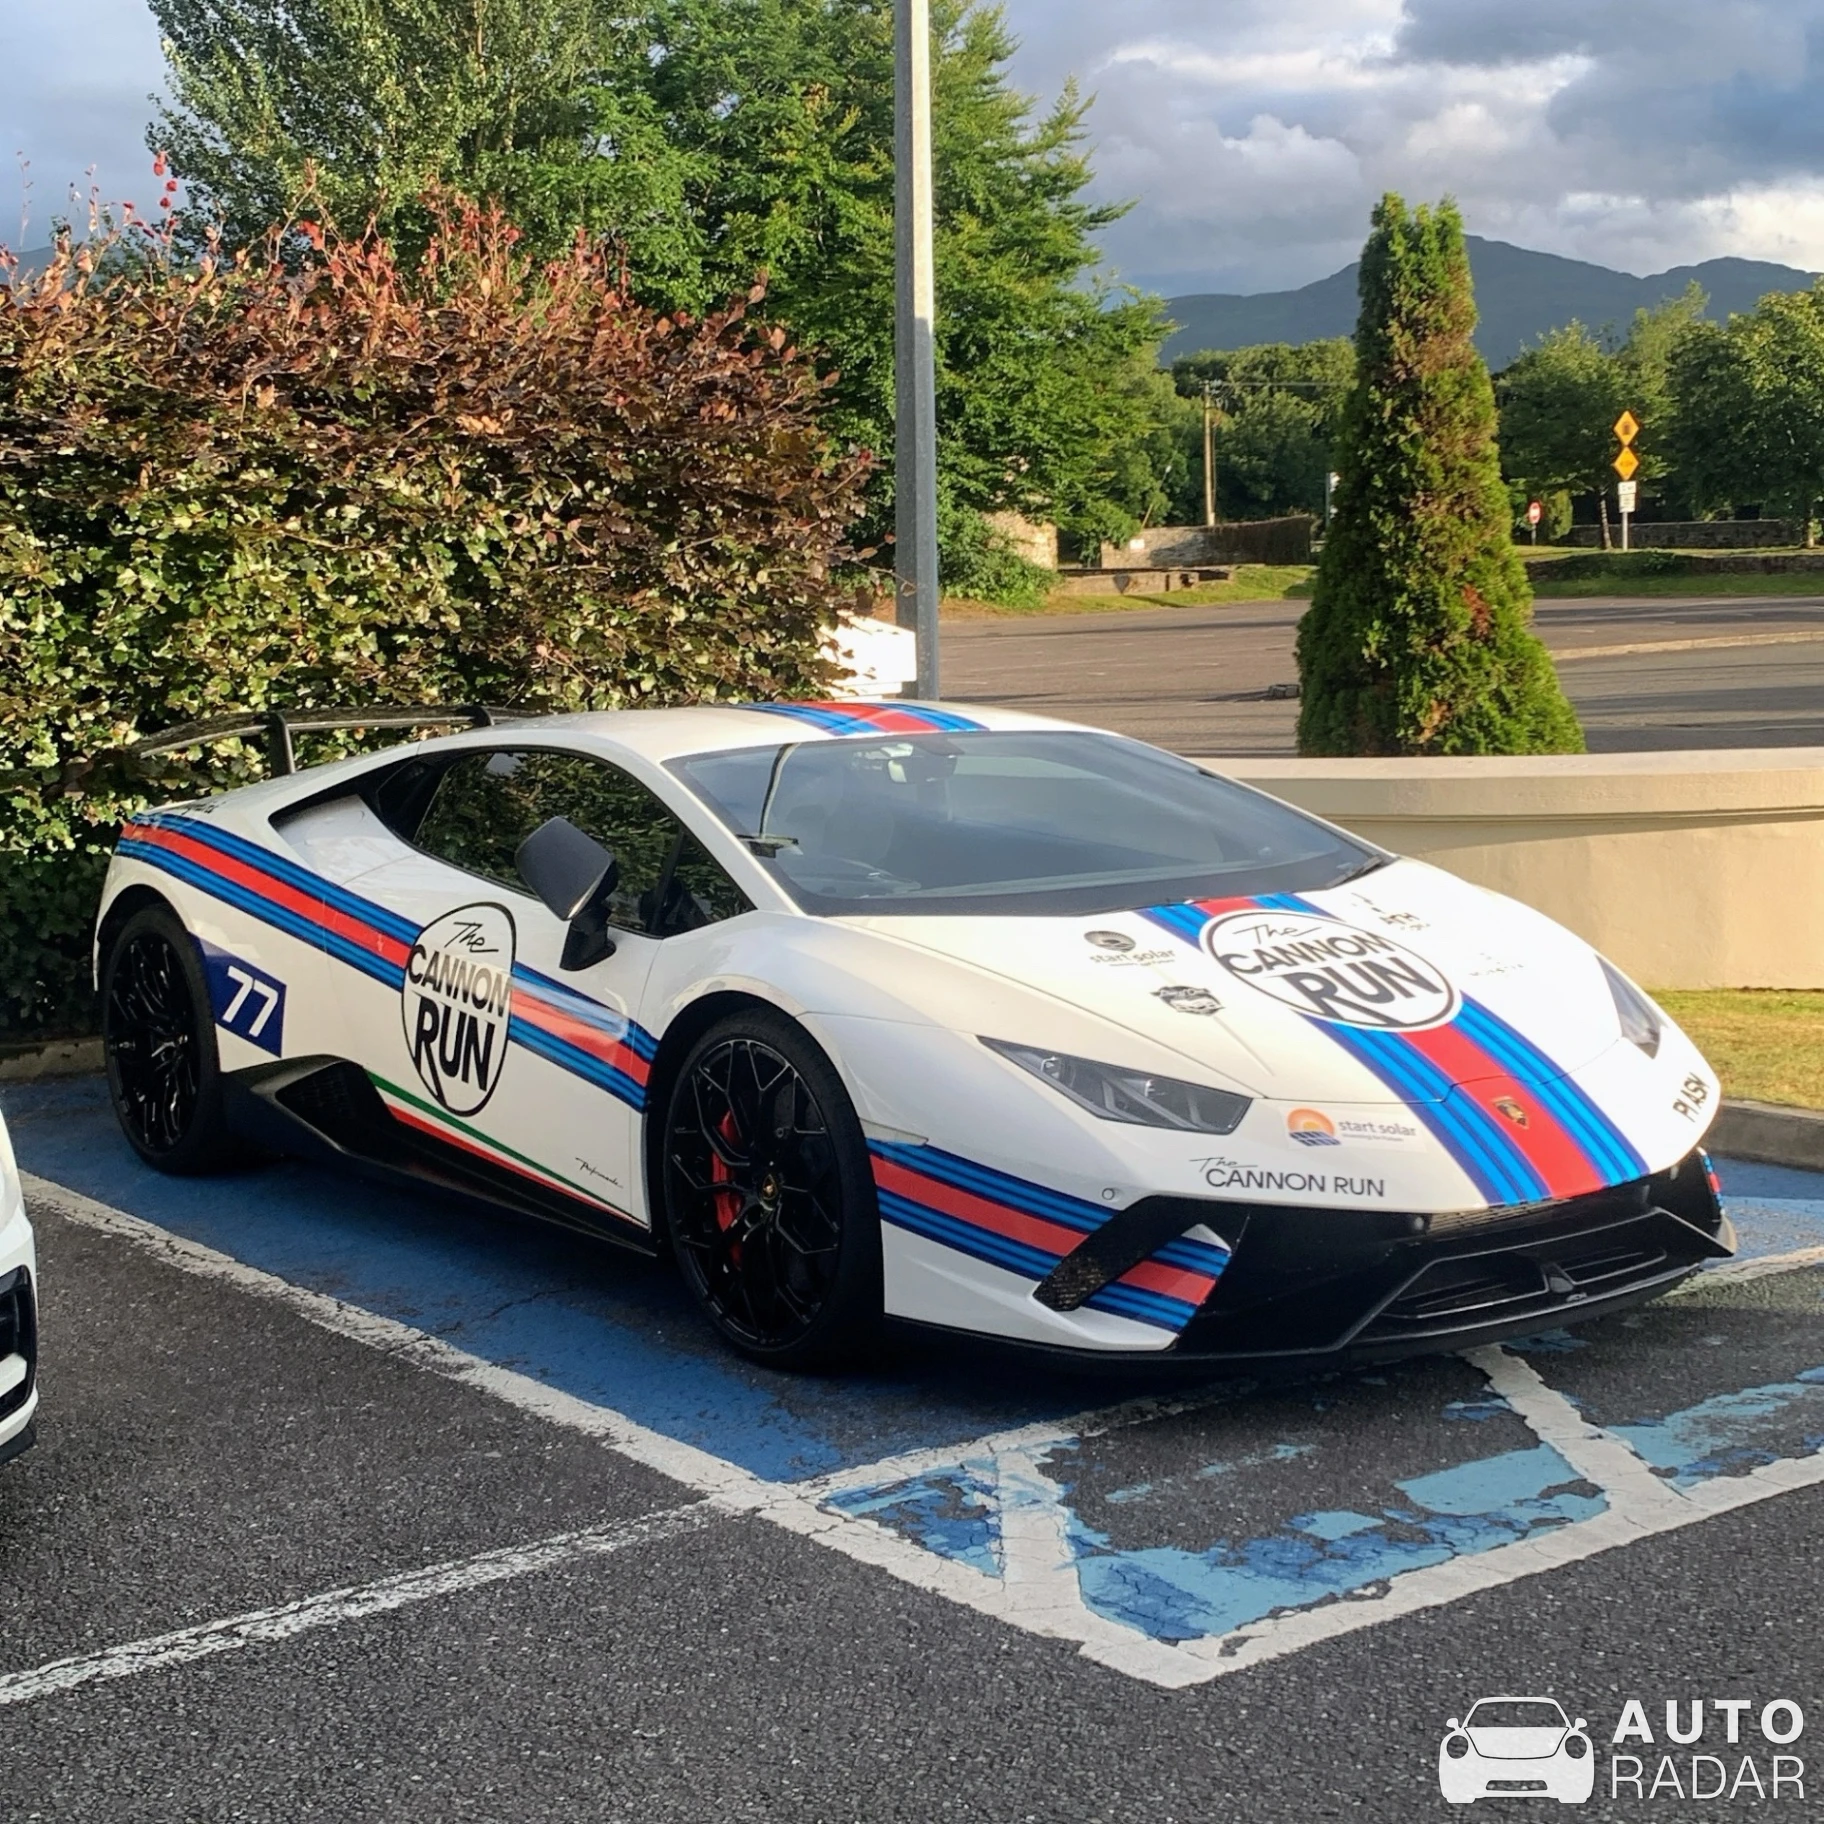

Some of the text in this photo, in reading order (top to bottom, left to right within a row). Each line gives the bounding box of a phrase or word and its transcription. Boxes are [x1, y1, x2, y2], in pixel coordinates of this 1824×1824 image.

[444, 921, 499, 953] The
[1217, 931, 1396, 975] CANNON
[1233, 923, 1323, 945] The
[408, 943, 513, 1018] CANNON
[1264, 956, 1444, 1028] RUN
[222, 965, 278, 1038] 77
[411, 989, 496, 1106] RUN
[1338, 1120, 1416, 1136] start solar
[1189, 1156, 1258, 1173] The
[1205, 1168, 1385, 1198] CANNON RUN
